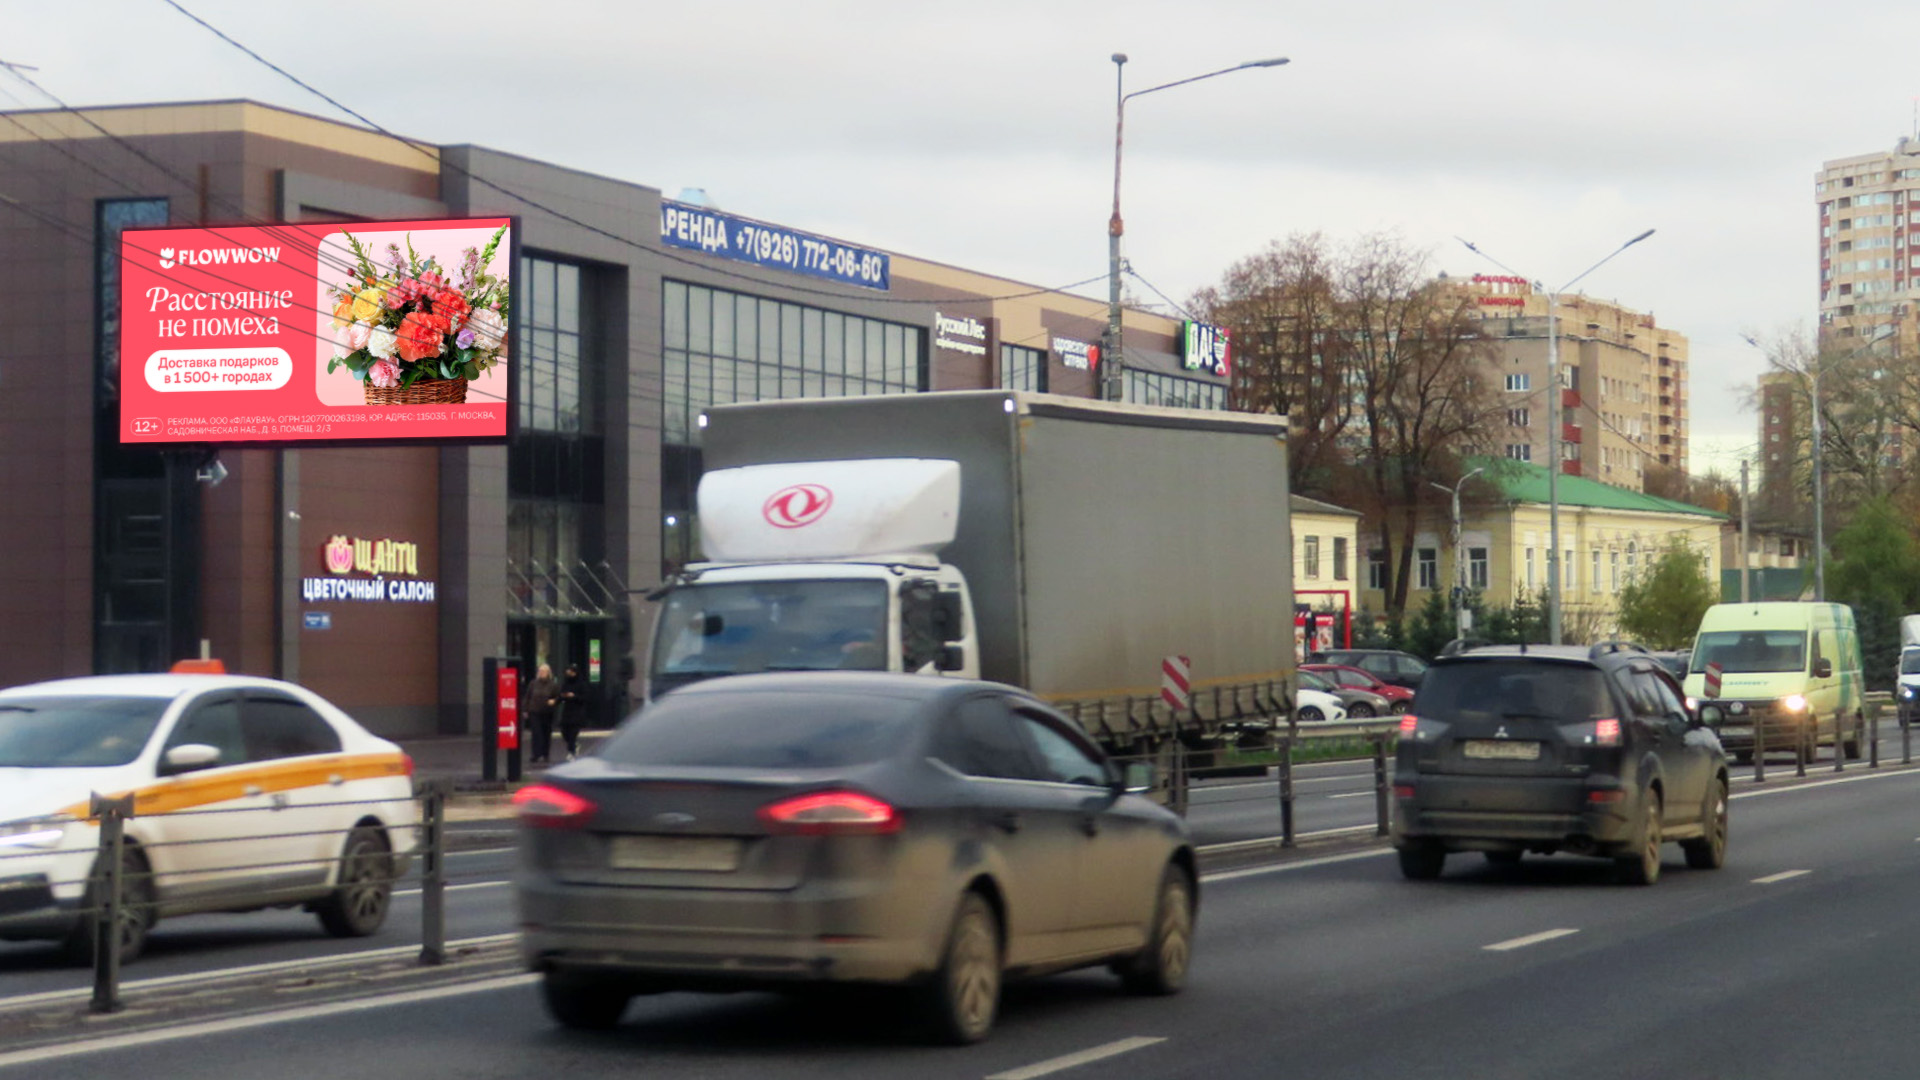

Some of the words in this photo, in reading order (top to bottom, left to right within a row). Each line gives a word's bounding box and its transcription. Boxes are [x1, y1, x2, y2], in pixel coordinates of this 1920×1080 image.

[179, 247, 281, 265] FLOWWOW
[736, 227, 798, 268] +7(926)
[803, 240, 882, 283] 772-06-60
[146, 287, 293, 312] Расстояние
[158, 318, 186, 337] не
[192, 316, 280, 336] помеха
[158, 357, 217, 371] Доставка
[220, 357, 279, 369] подарков
[164, 375, 171, 383] в
[222, 373, 272, 385] городах
[210, 416, 228, 425] ООО
[278, 414, 300, 423] ОГРН
[385, 412, 415, 423] АДРЕС:
[458, 411, 496, 421] МОСКВА,
[135, 420, 158, 433] 12+
[316, 424, 331, 433] 2/3
[303, 575, 385, 602] ЦВЕТОЧНЫЙ
[389, 580, 435, 600] САЛОН
